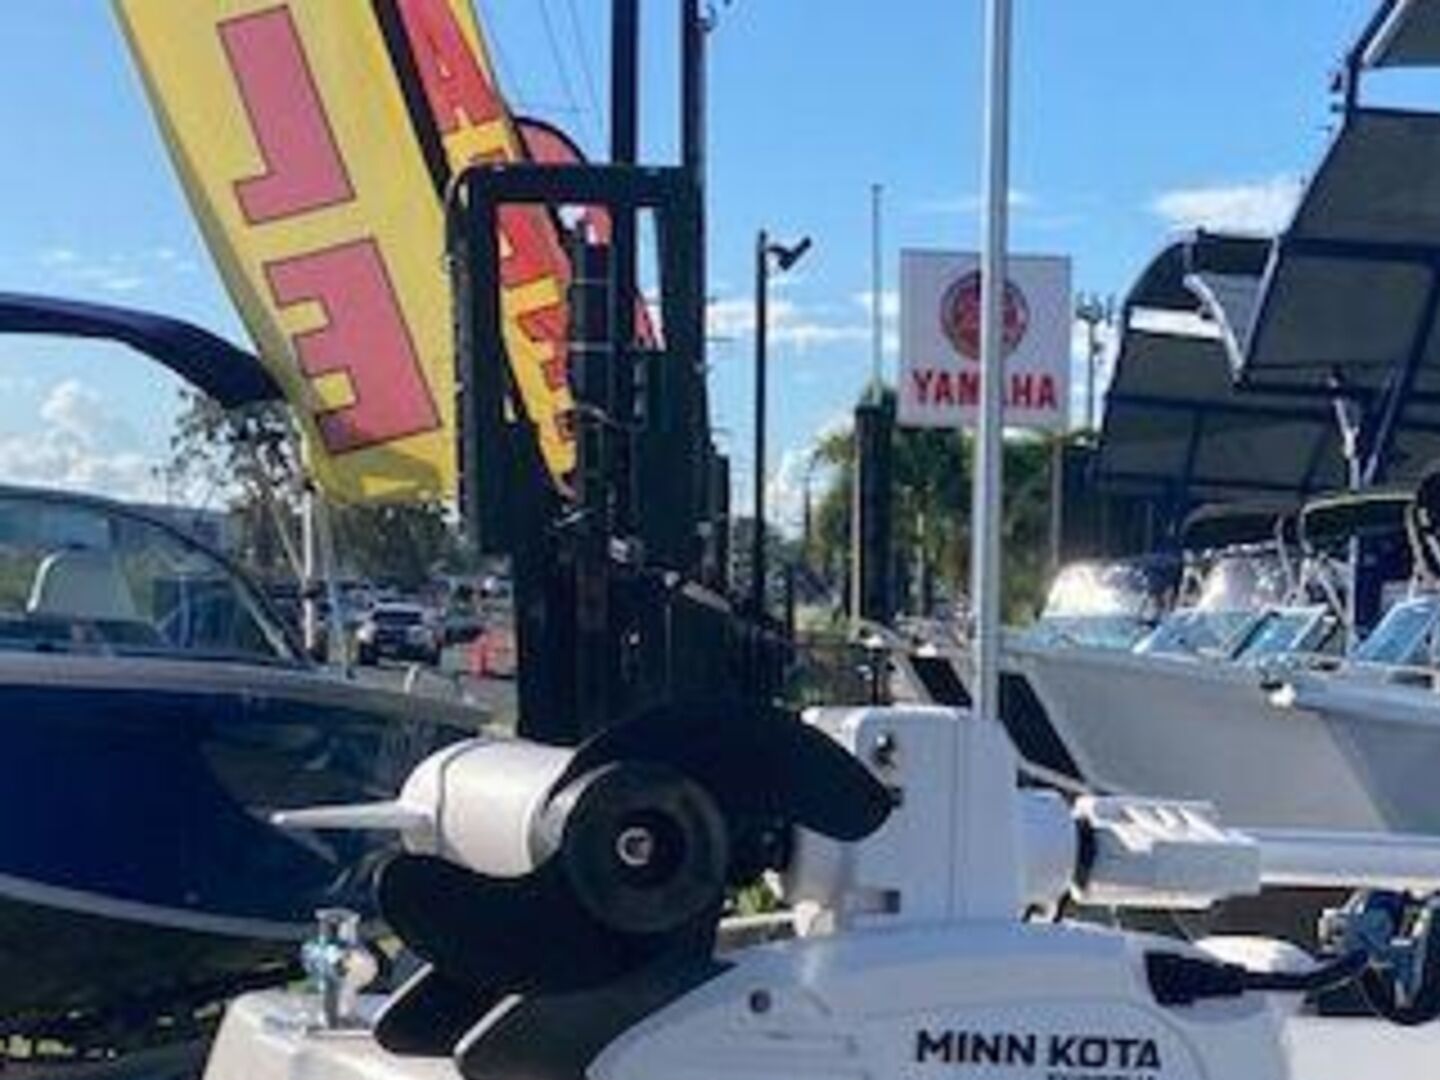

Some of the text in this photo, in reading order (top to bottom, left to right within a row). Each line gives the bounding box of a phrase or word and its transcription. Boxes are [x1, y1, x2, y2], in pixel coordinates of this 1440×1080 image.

[912, 369, 1057, 410] YAMHA
[916, 1029, 1161, 1070] MINN KOTA
